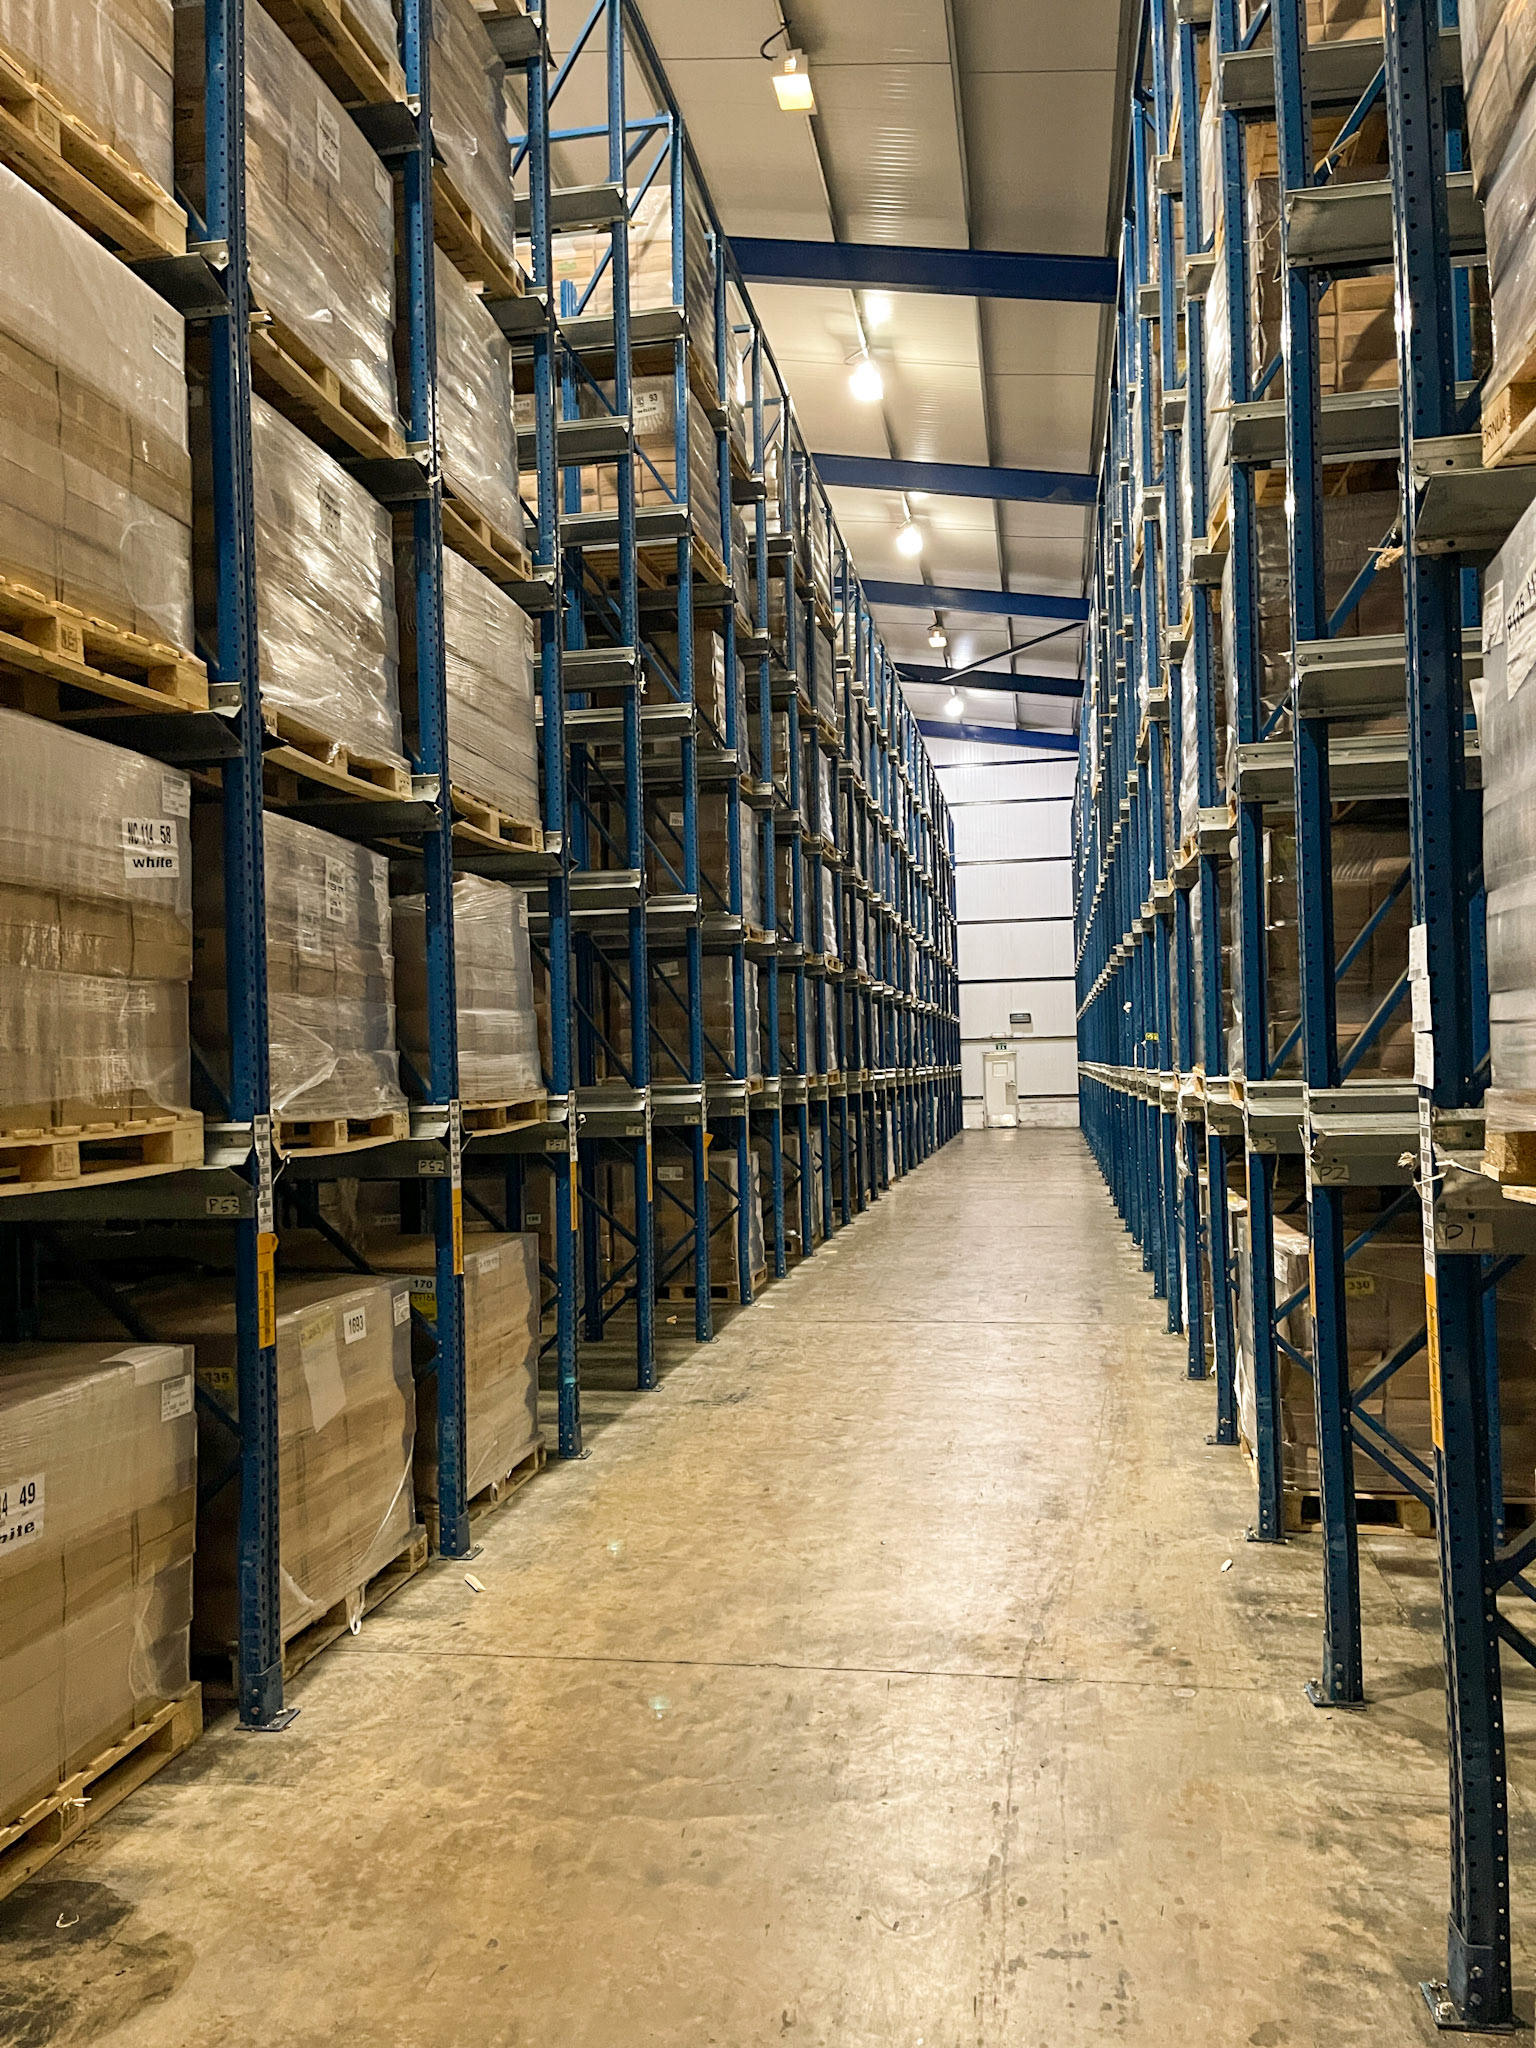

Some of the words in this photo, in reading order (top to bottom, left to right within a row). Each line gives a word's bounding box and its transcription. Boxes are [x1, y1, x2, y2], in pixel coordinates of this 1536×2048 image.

[160, 825, 171, 845] 58
[133, 856, 173, 868] white
[1319, 1166, 1349, 1182] P2
[209, 1198, 239, 1214] P53
[1445, 1224, 1476, 1248] P1
[414, 1279, 433, 1289] 170
[348, 1315, 363, 1334] 1693
[19, 1482, 36, 1507] 49
